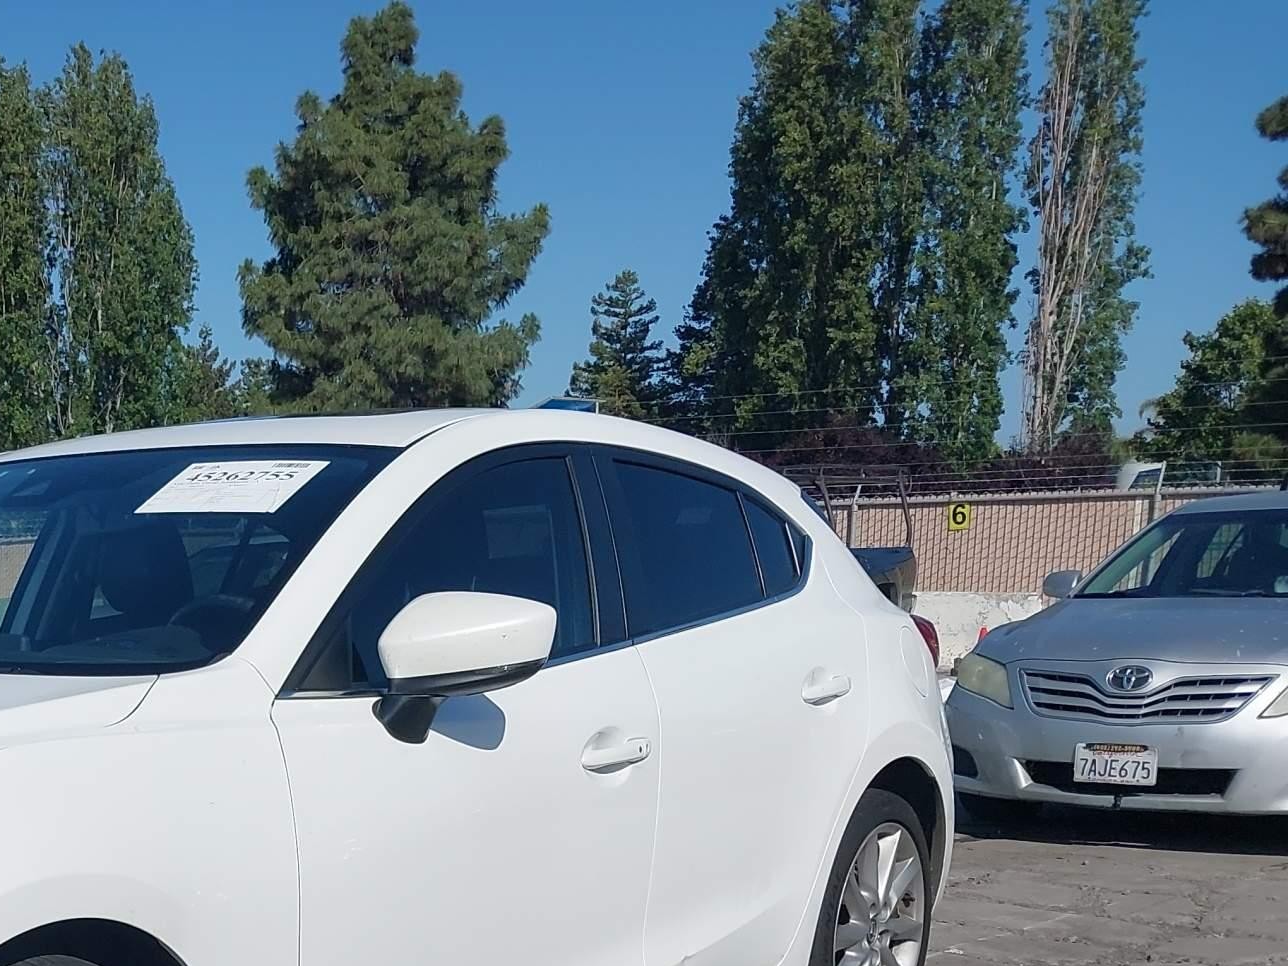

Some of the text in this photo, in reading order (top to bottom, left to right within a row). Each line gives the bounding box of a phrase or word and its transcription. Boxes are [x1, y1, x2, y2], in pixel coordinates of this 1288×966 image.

[185, 470, 299, 482] 45262755
[952, 504, 967, 525] 6
[1079, 758, 1151, 780] 7AJE675
